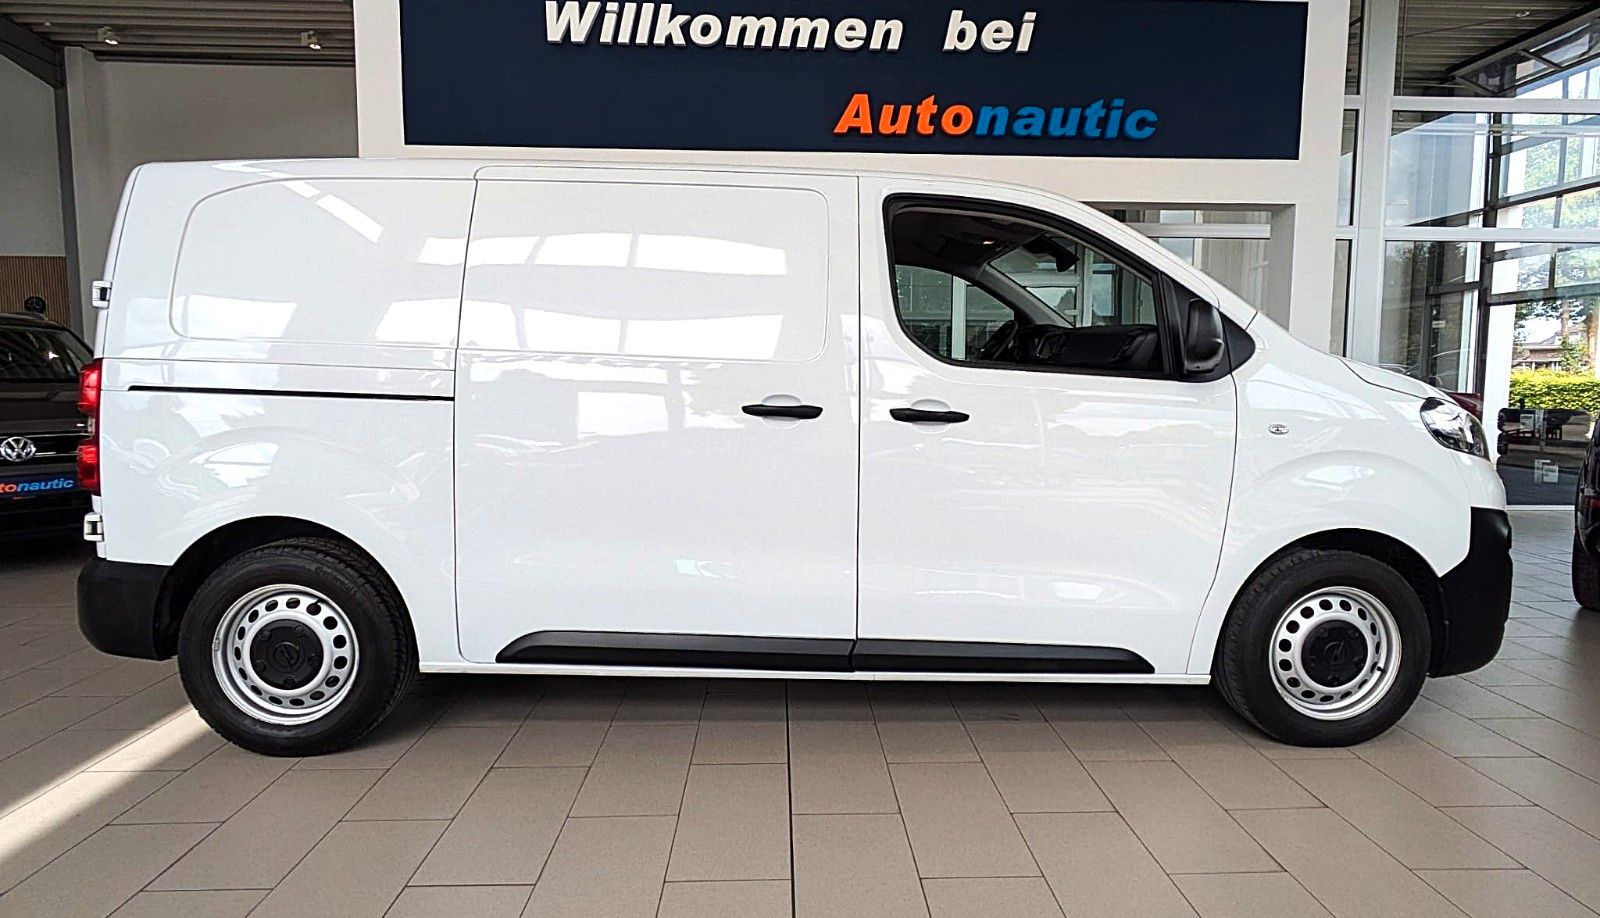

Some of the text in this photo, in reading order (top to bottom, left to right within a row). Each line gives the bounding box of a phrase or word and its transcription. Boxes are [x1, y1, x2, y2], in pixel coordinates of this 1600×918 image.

[545, 1, 1037, 53] Willkommen bei
[833, 93, 1158, 139] Autonautic
